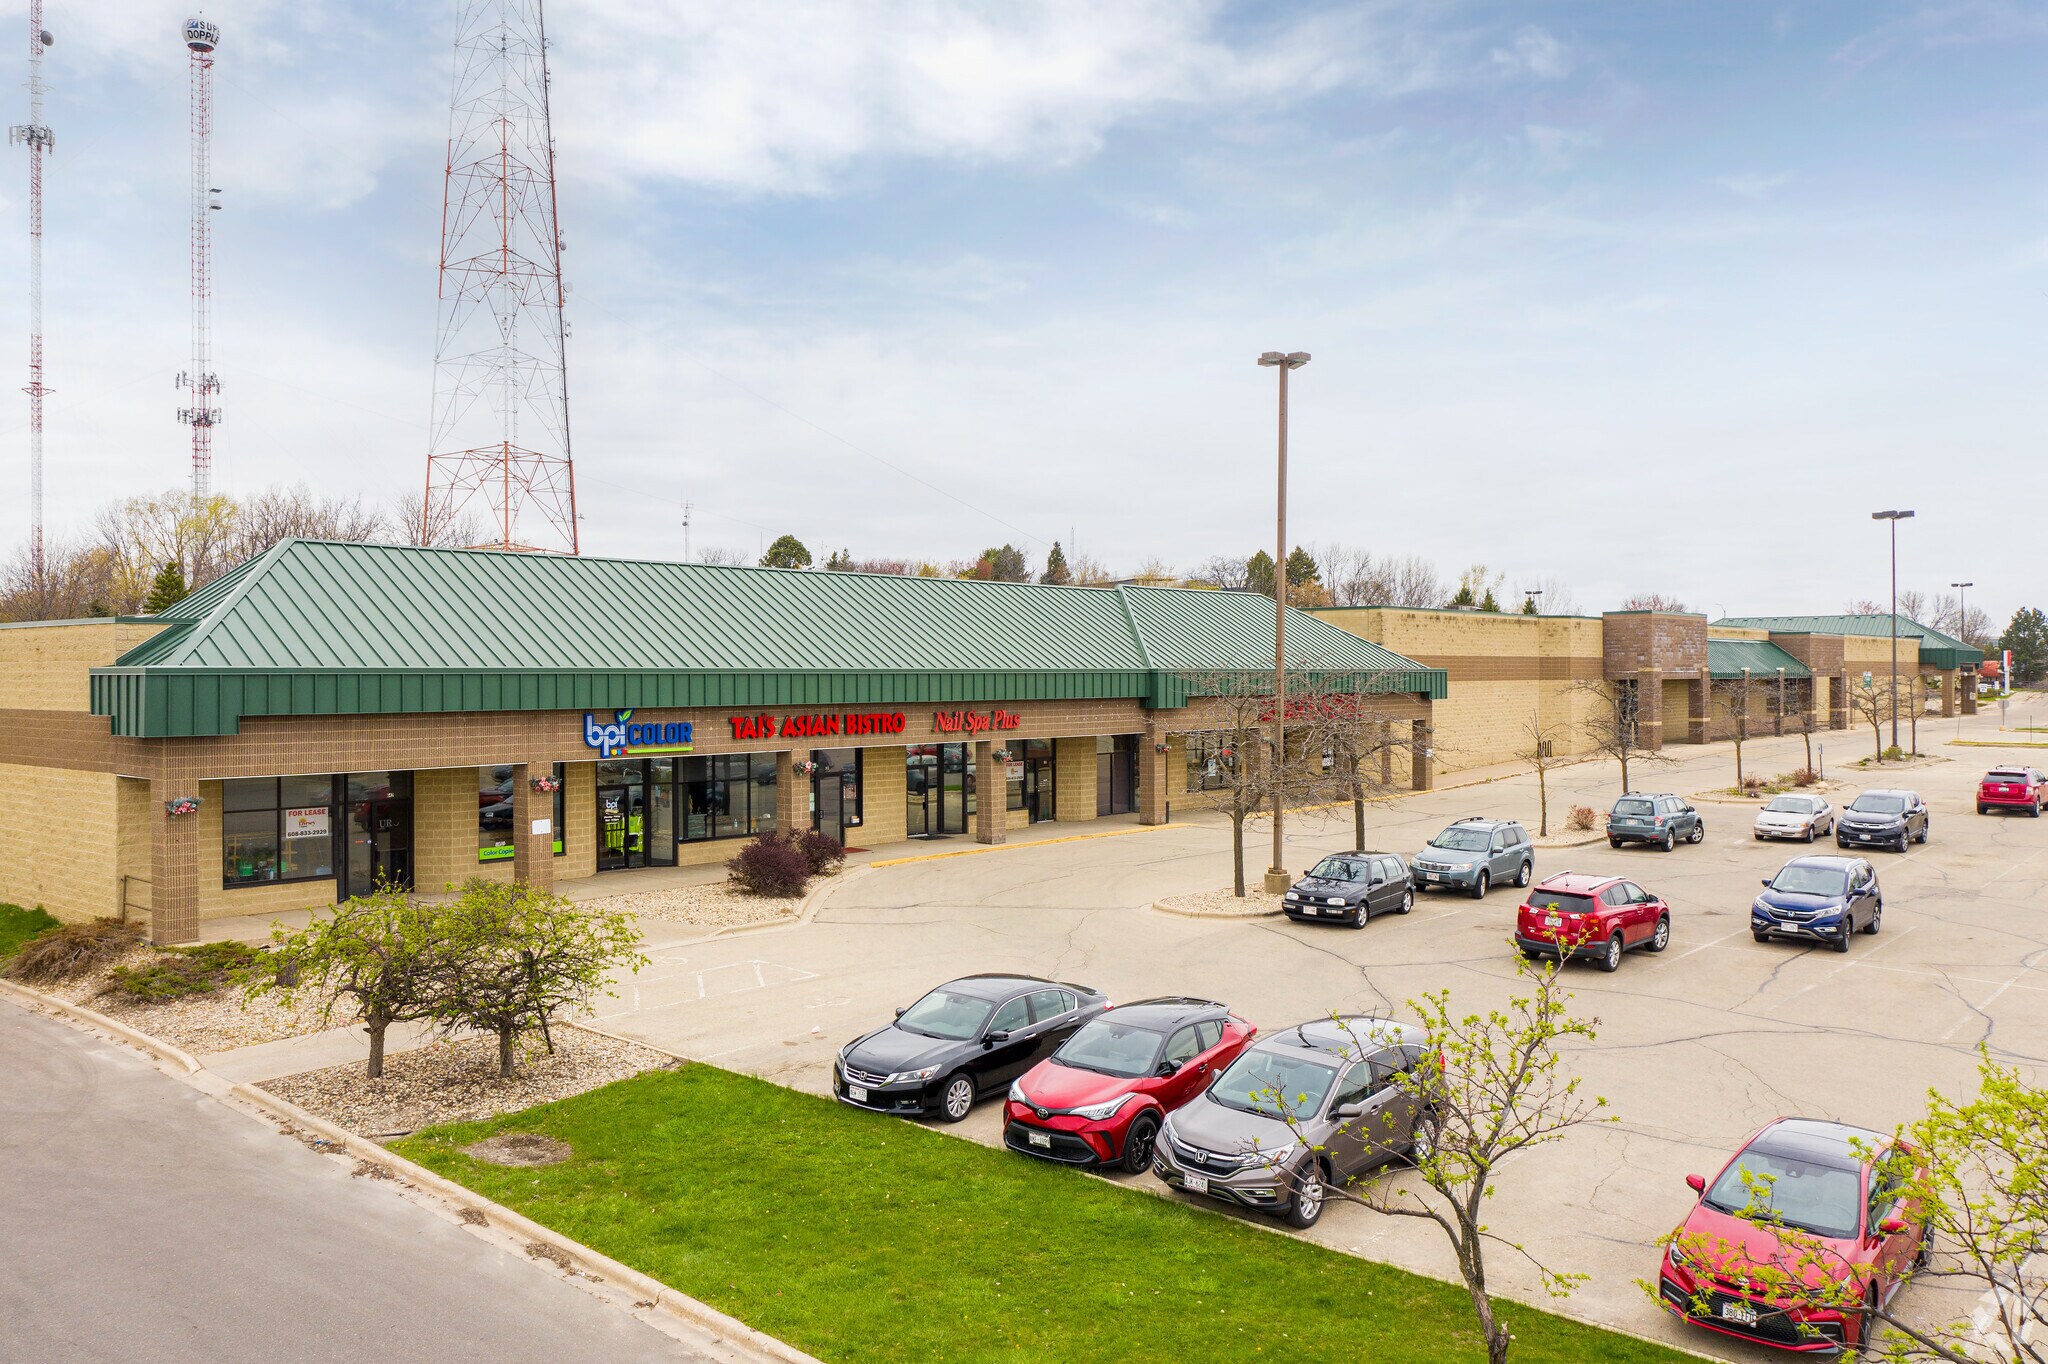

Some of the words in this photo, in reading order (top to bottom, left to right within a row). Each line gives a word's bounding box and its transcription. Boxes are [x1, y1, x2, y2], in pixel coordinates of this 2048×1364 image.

[585, 713, 627, 757] bpi
[628, 722, 693, 745] COLOR
[730, 714, 776, 739] TAI'S
[781, 714, 840, 738] ASIAN
[845, 712, 906, 735] BISTRO
[934, 711, 963, 732] Nail
[964, 710, 990, 735] Spa
[992, 710, 1020, 730] Plus
[287, 829, 327, 837] 608-833-2929
[498, 848, 514, 857] Copie
